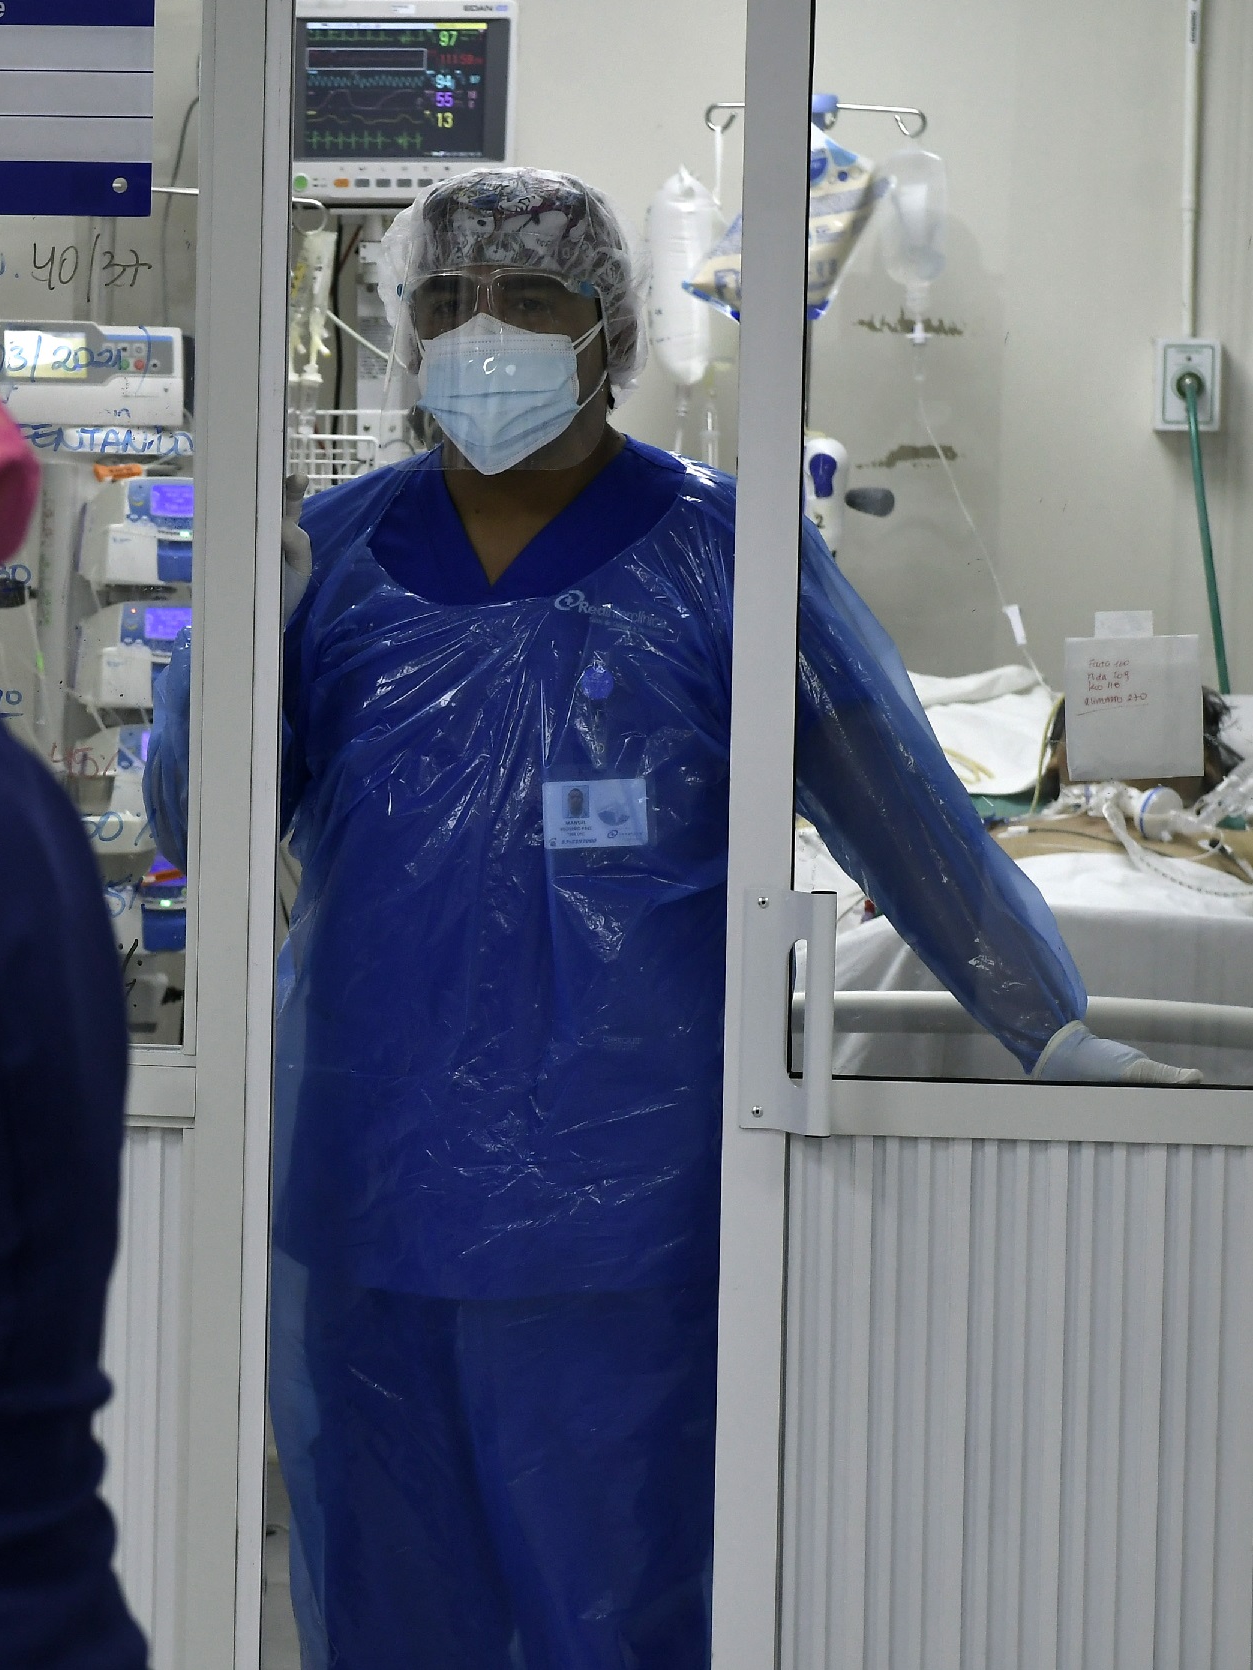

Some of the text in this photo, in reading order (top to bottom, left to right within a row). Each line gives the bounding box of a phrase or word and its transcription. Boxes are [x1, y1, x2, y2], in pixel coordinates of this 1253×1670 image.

[438, 31, 458, 47] 97
[435, 91, 455, 108] 55
[437, 112, 454, 128] 13
